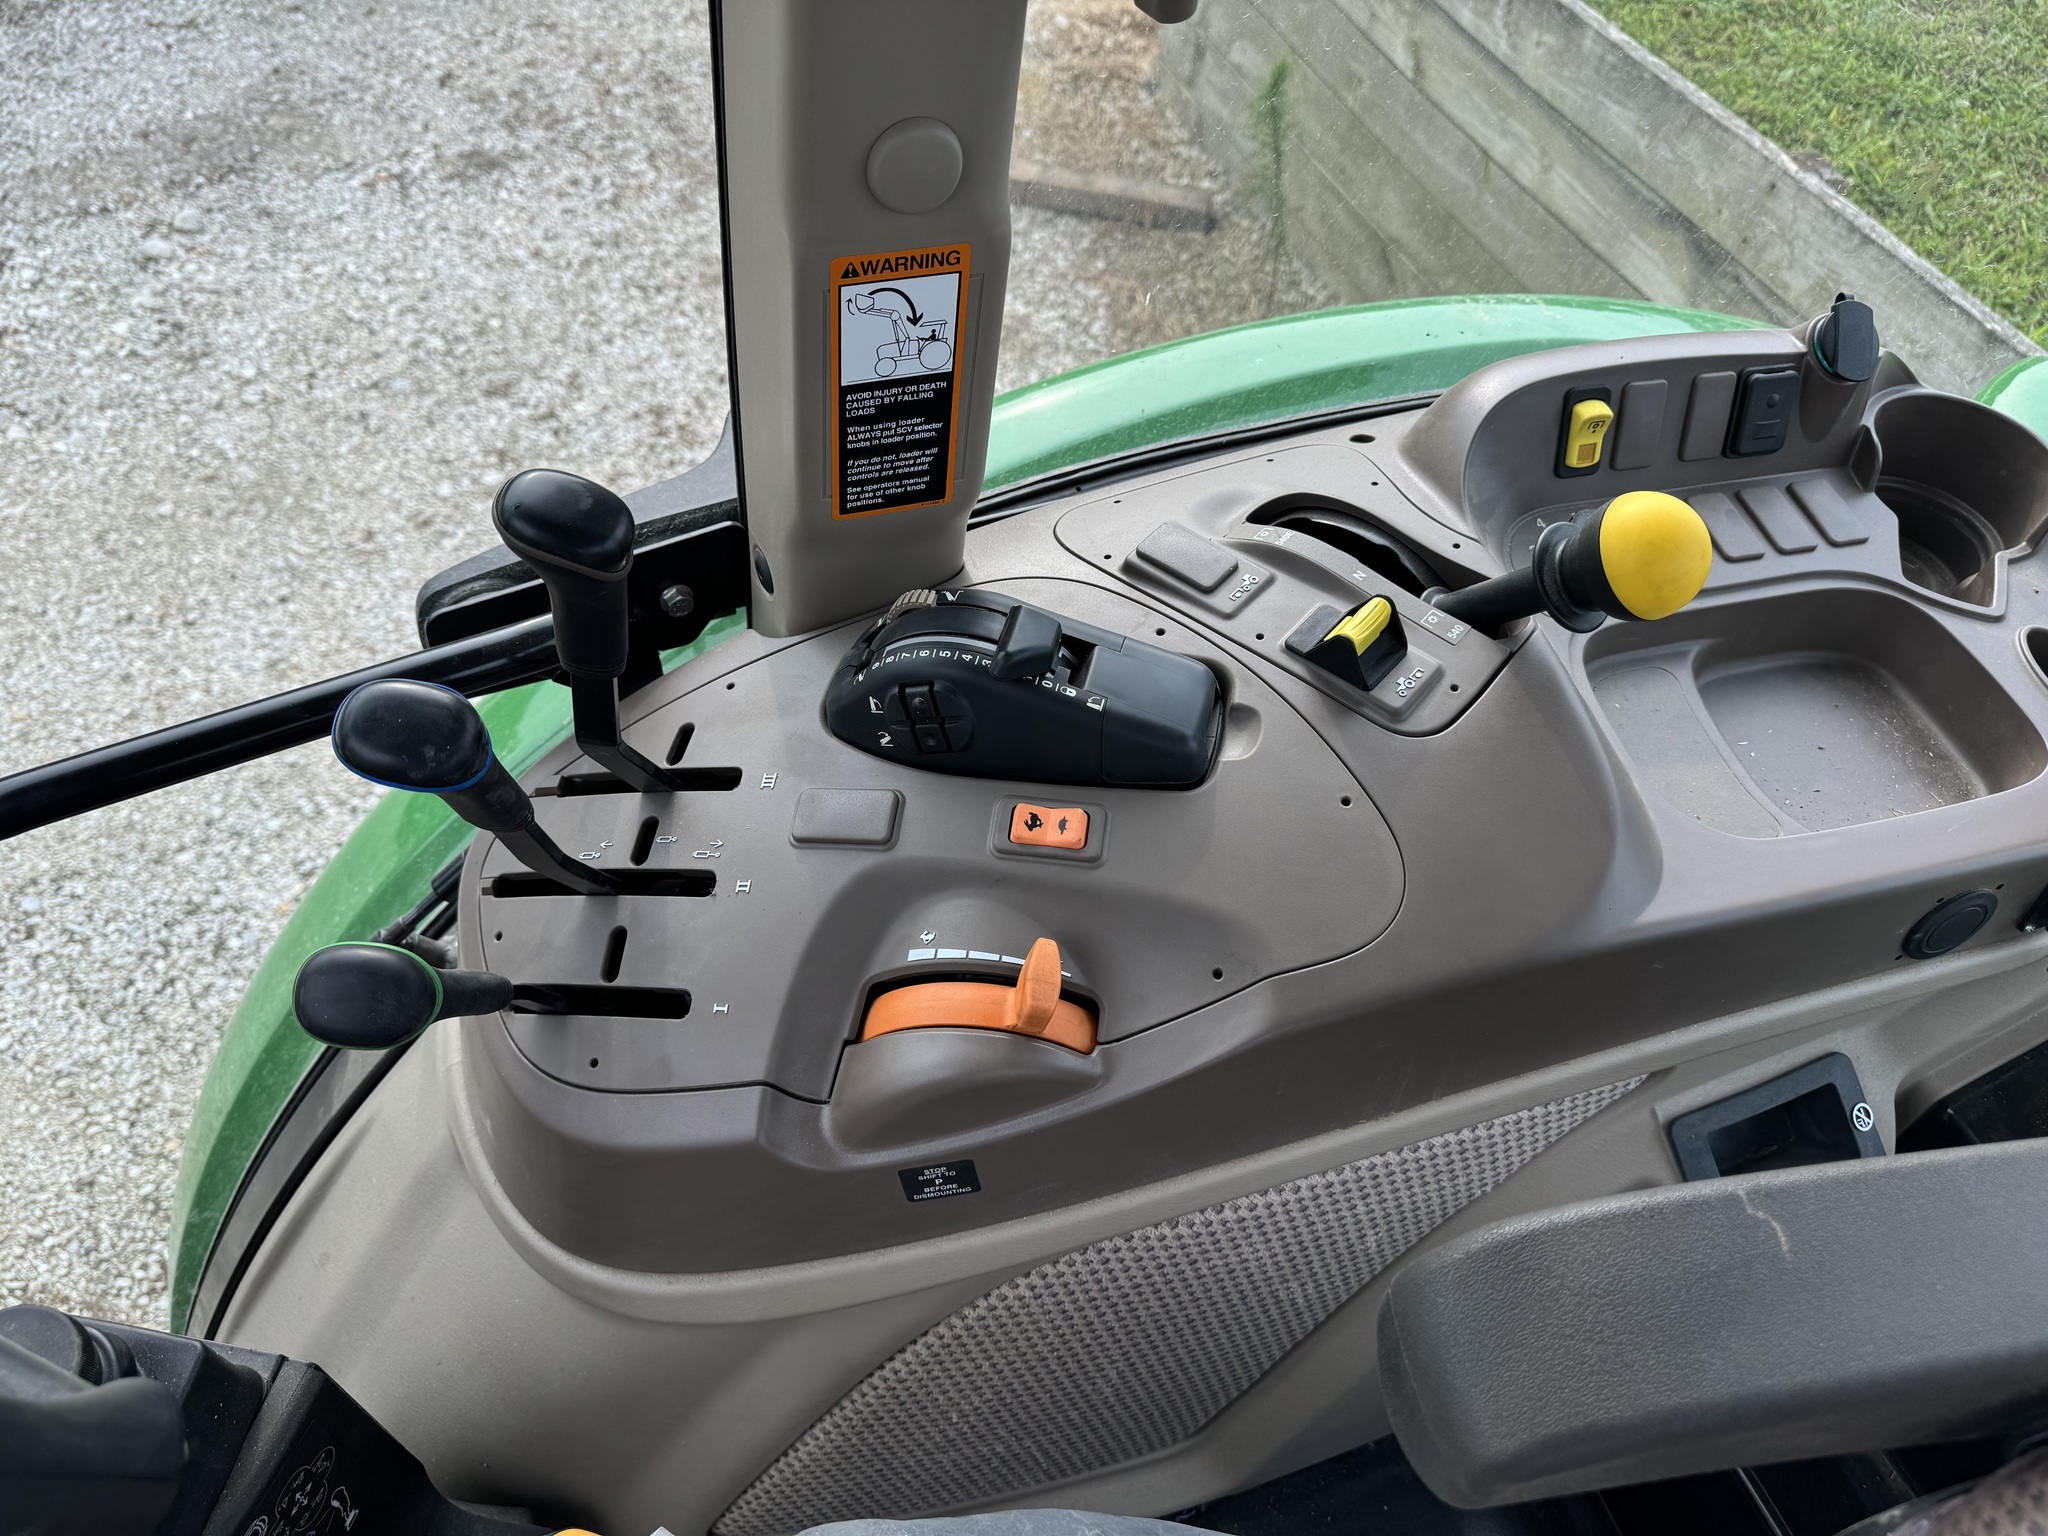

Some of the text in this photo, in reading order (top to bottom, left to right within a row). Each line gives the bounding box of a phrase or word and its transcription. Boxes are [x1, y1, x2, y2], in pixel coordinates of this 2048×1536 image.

[860, 250, 961, 276] WARNING
[846, 392, 872, 401] AVOID
[874, 387, 904, 397] INJURY
[919, 381, 947, 391] DEATH
[846, 391, 934, 409] CAUSED BY FALLING
[846, 407, 875, 417] LOADS
[847, 417, 925, 433] When using loader
[847, 422, 943, 441] ALWAYS put SCV selector
[847, 440, 870, 449] knobs
[881, 435, 904, 444] loader
[906, 431, 937, 441] position.
[847, 464, 881, 474] continue
[916, 456, 934, 464] after
[854, 459, 869, 467] you
[899, 450, 923, 459] loader
[847, 471, 879, 481] controls
[895, 463, 929, 474] released.
[863, 481, 900, 491] operators
[902, 475, 930, 485] manual
[885, 487, 905, 495] other
[847, 498, 884, 508] positions.
[1536, 518, 1546, 528] 4
[1275, 530, 1296, 546] 540E
[1352, 570, 1367, 580] N
[1446, 624, 1464, 639] 540
[885, 655, 894, 663] 8
[961, 653, 973, 661] 4
[981, 659, 991, 667] 3
[924, 1167, 947, 1175] STOP
[913, 1187, 972, 1200] DISMOUNTING
[924, 1183, 958, 1193] BEFORE
